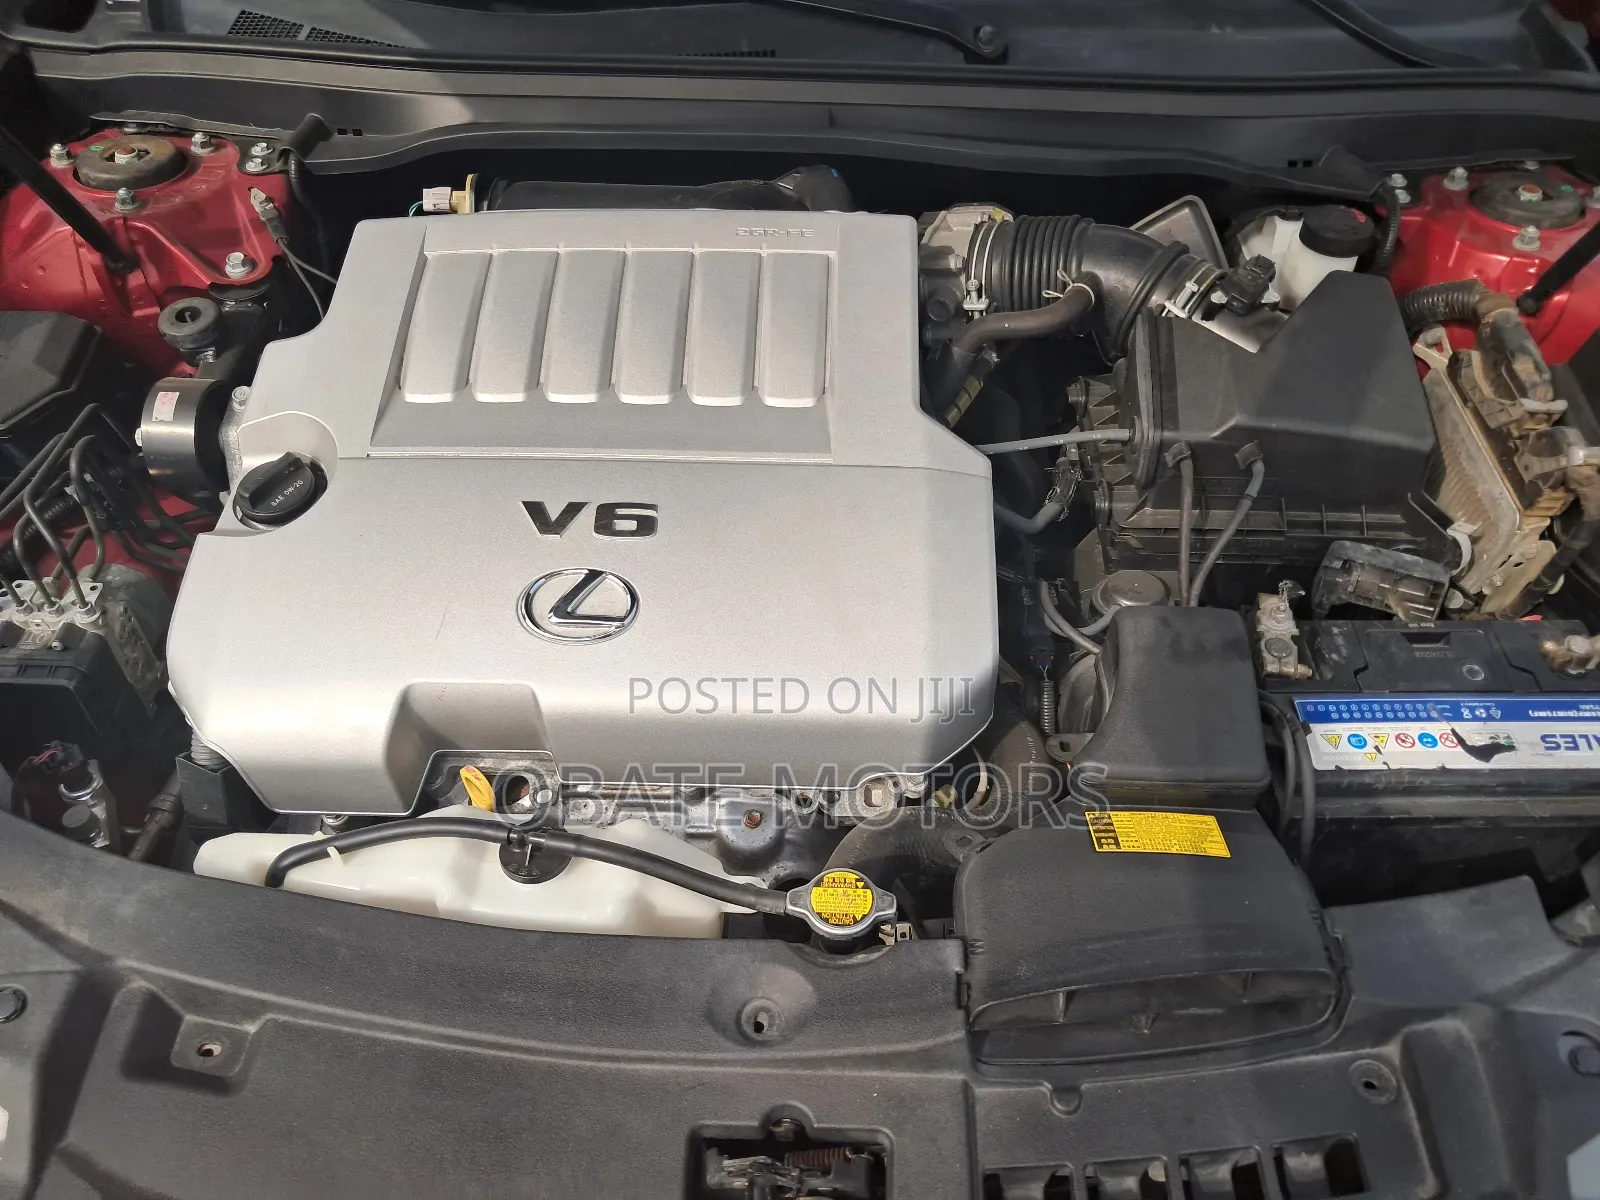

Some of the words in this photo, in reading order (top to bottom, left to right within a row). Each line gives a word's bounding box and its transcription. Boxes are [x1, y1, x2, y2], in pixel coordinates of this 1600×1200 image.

[735, 227, 815, 238] 2GR-FE
[271, 494, 284, 507] SAE
[283, 479, 304, 496] 0W-20
[520, 500, 658, 541] V6
